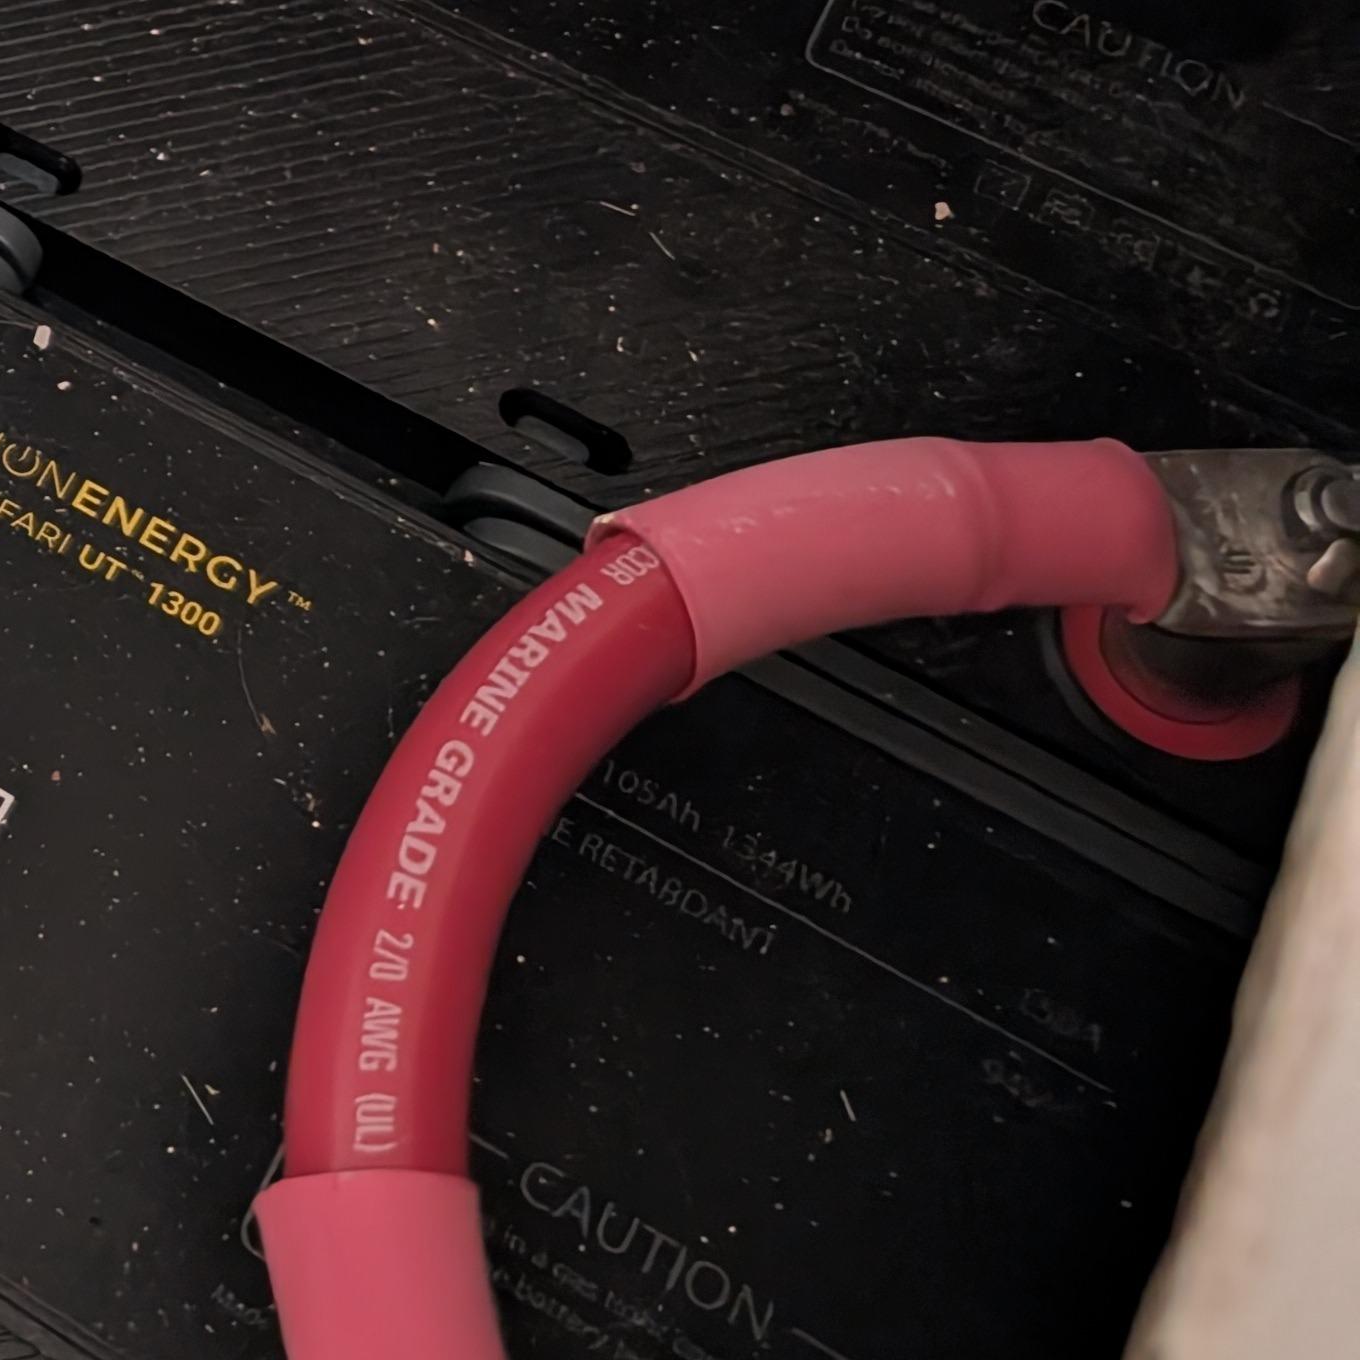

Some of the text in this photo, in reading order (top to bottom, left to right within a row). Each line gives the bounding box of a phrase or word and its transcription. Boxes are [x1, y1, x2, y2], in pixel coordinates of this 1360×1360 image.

[146, 580, 223, 638] 1300
[458, 581, 606, 738] MARINE
[385, 738, 477, 911] GRADE
[598, 758, 704, 833] 105Ah
[368, 928, 416, 983] 2/0
[358, 996, 404, 1073] AWG
[352, 1092, 400, 1154] (UL)
[520, 1160, 775, 1344] CAUTION
